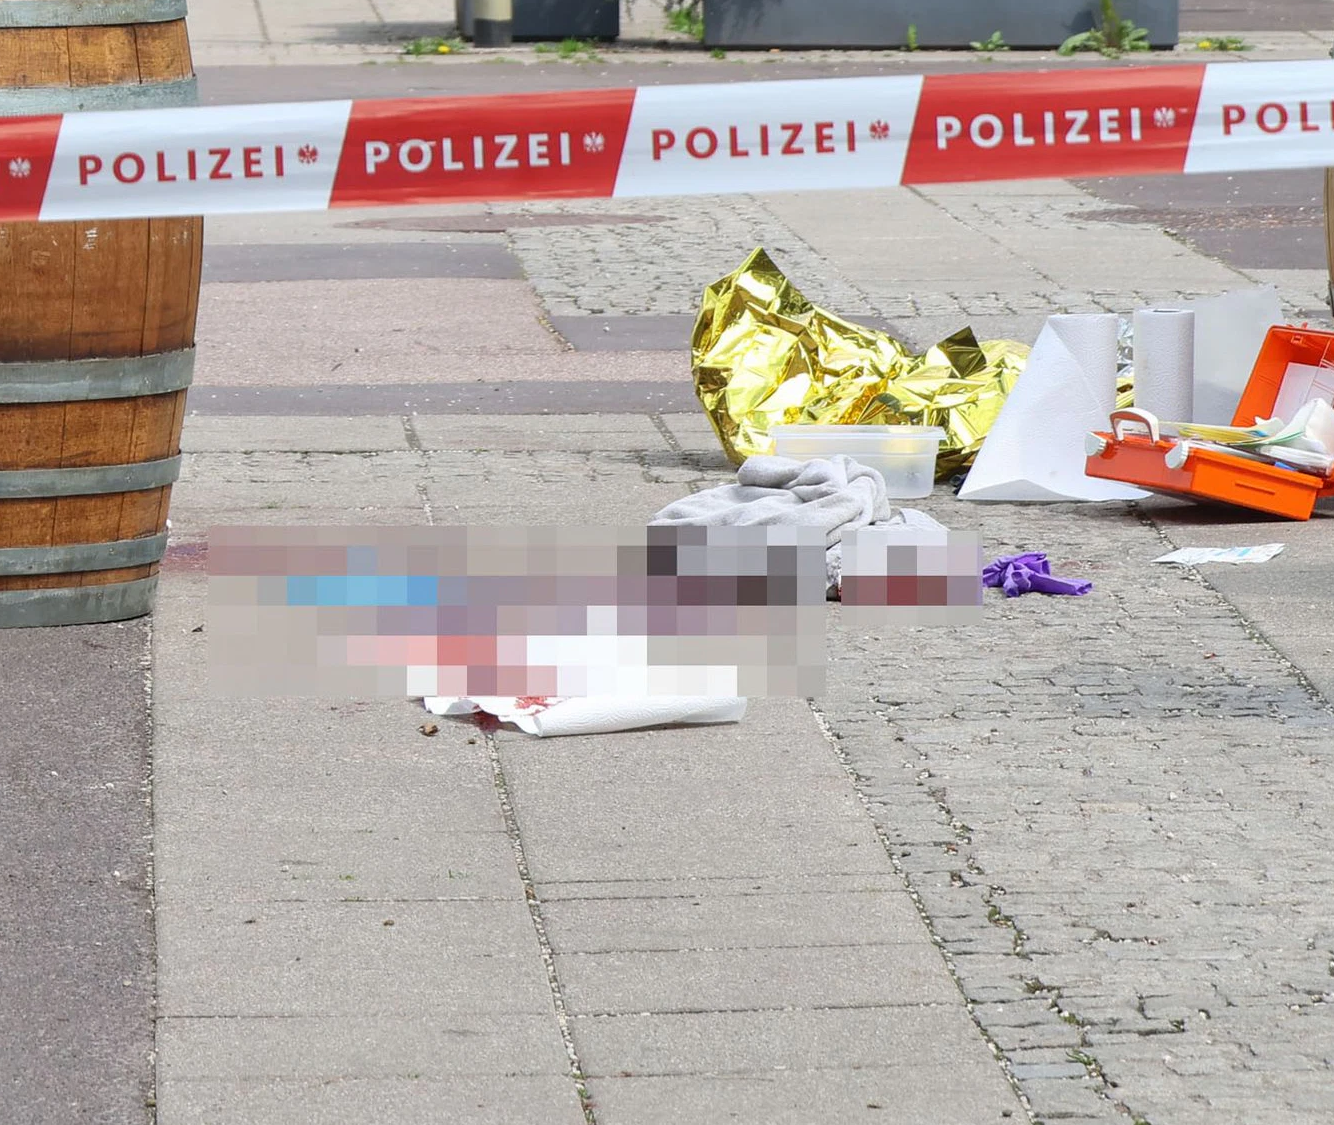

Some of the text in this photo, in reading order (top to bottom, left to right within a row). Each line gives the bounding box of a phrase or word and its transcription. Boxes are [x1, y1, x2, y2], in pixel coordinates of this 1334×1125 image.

[78, 145, 284, 186] POLIZEI
[365, 132, 571, 173] POLIZEI
[652, 120, 855, 160] POLIZEI
[936, 107, 1141, 150] POLIZEI
